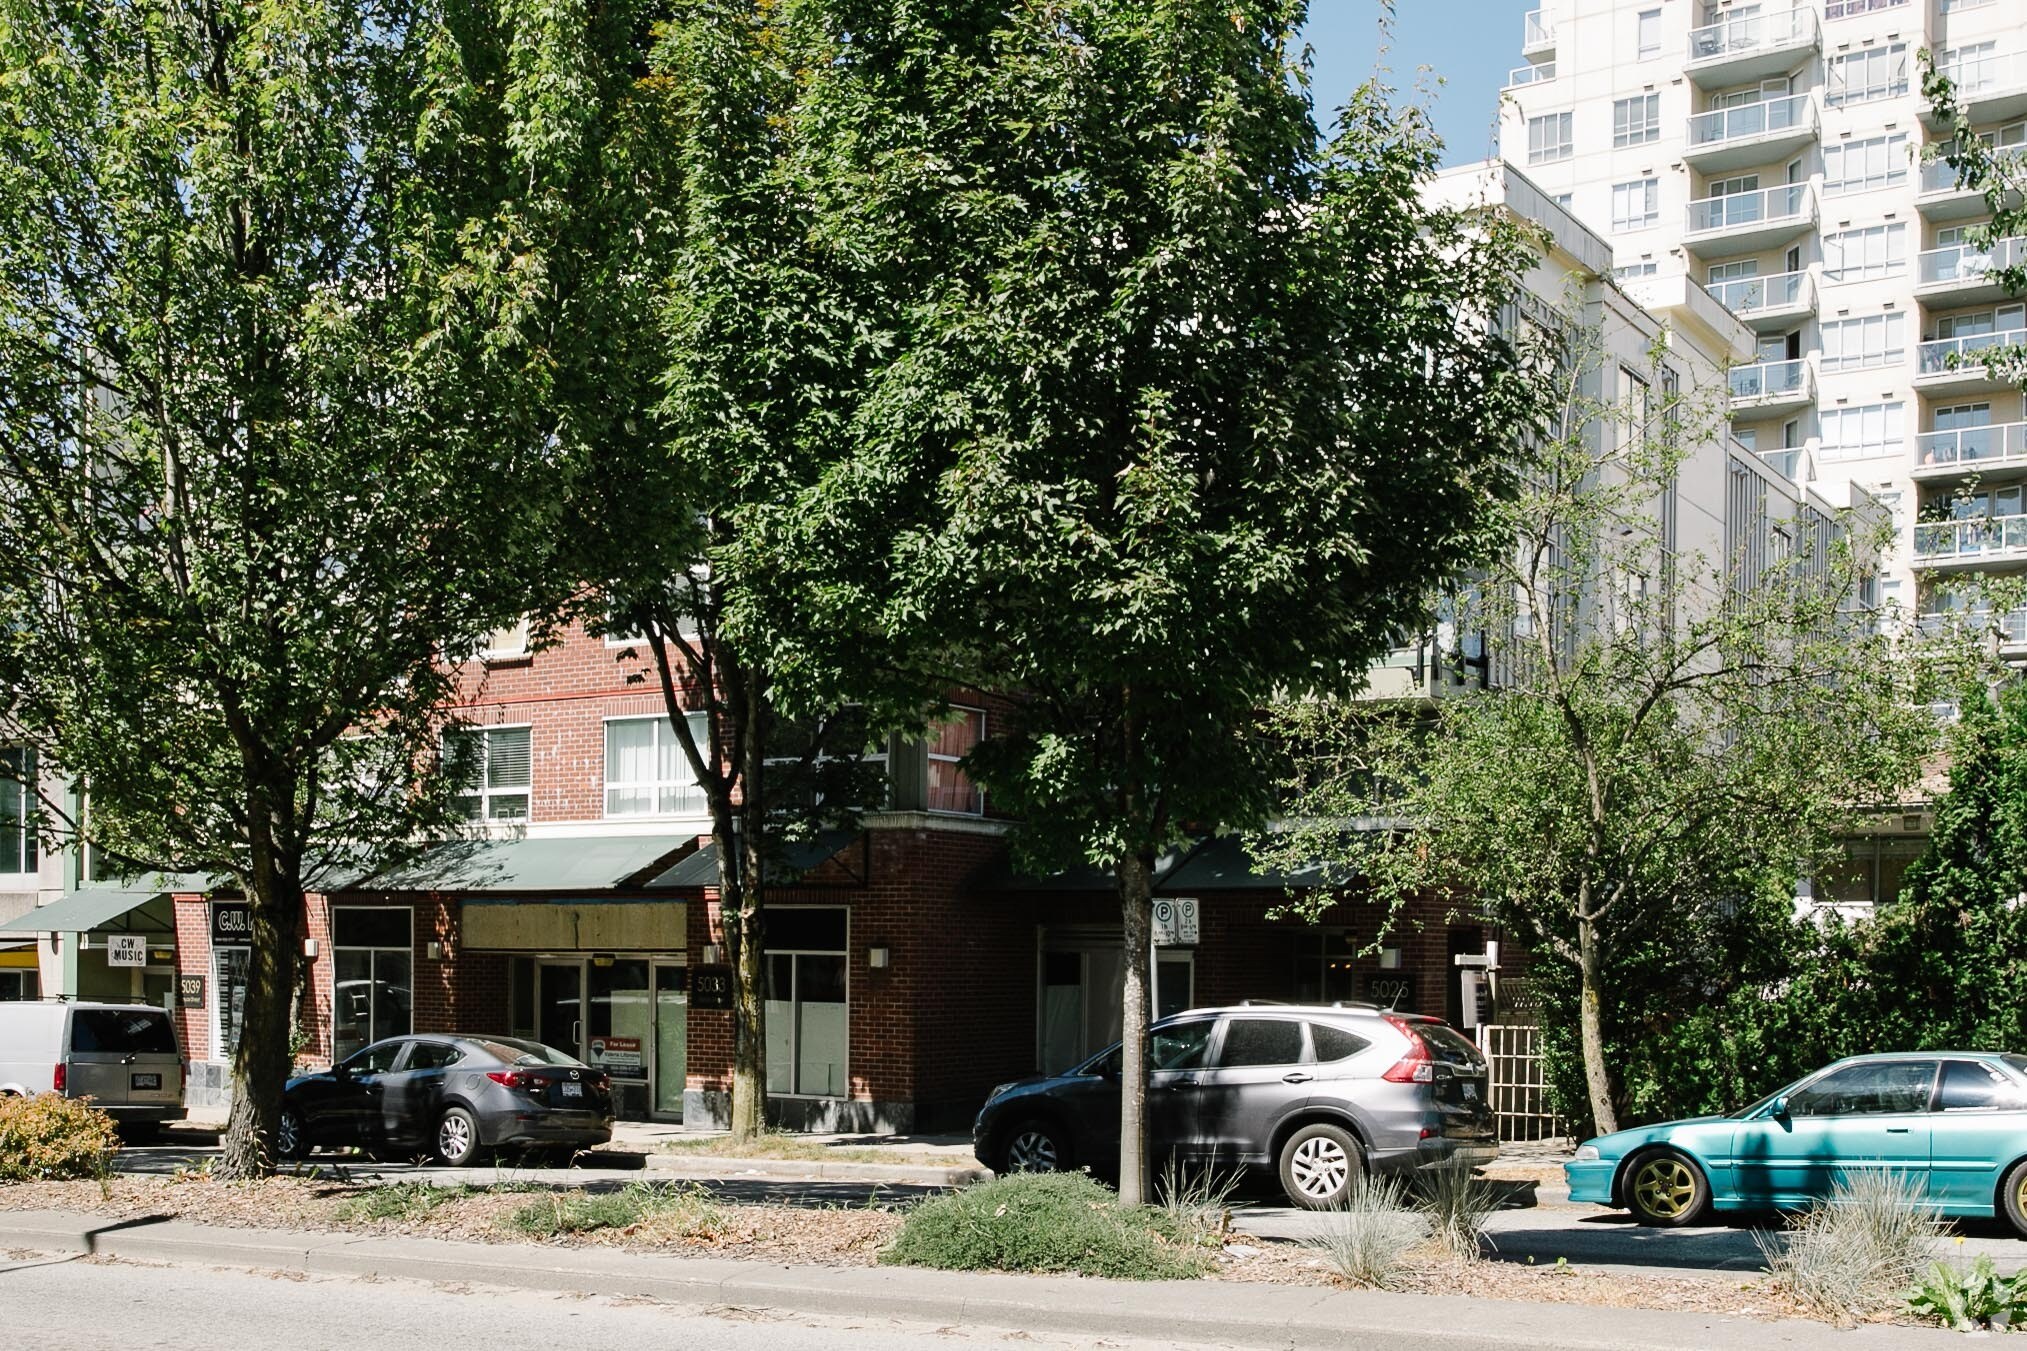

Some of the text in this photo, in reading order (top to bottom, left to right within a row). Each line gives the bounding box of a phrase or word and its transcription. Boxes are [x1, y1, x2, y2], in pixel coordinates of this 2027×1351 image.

[218, 910, 246, 931] C.W.
[121, 938, 135, 949] CW
[113, 949, 144, 961] MUSIC
[181, 979, 201, 994] 5039
[697, 976, 727, 993] 5033
[1370, 980, 1409, 998] 5025
